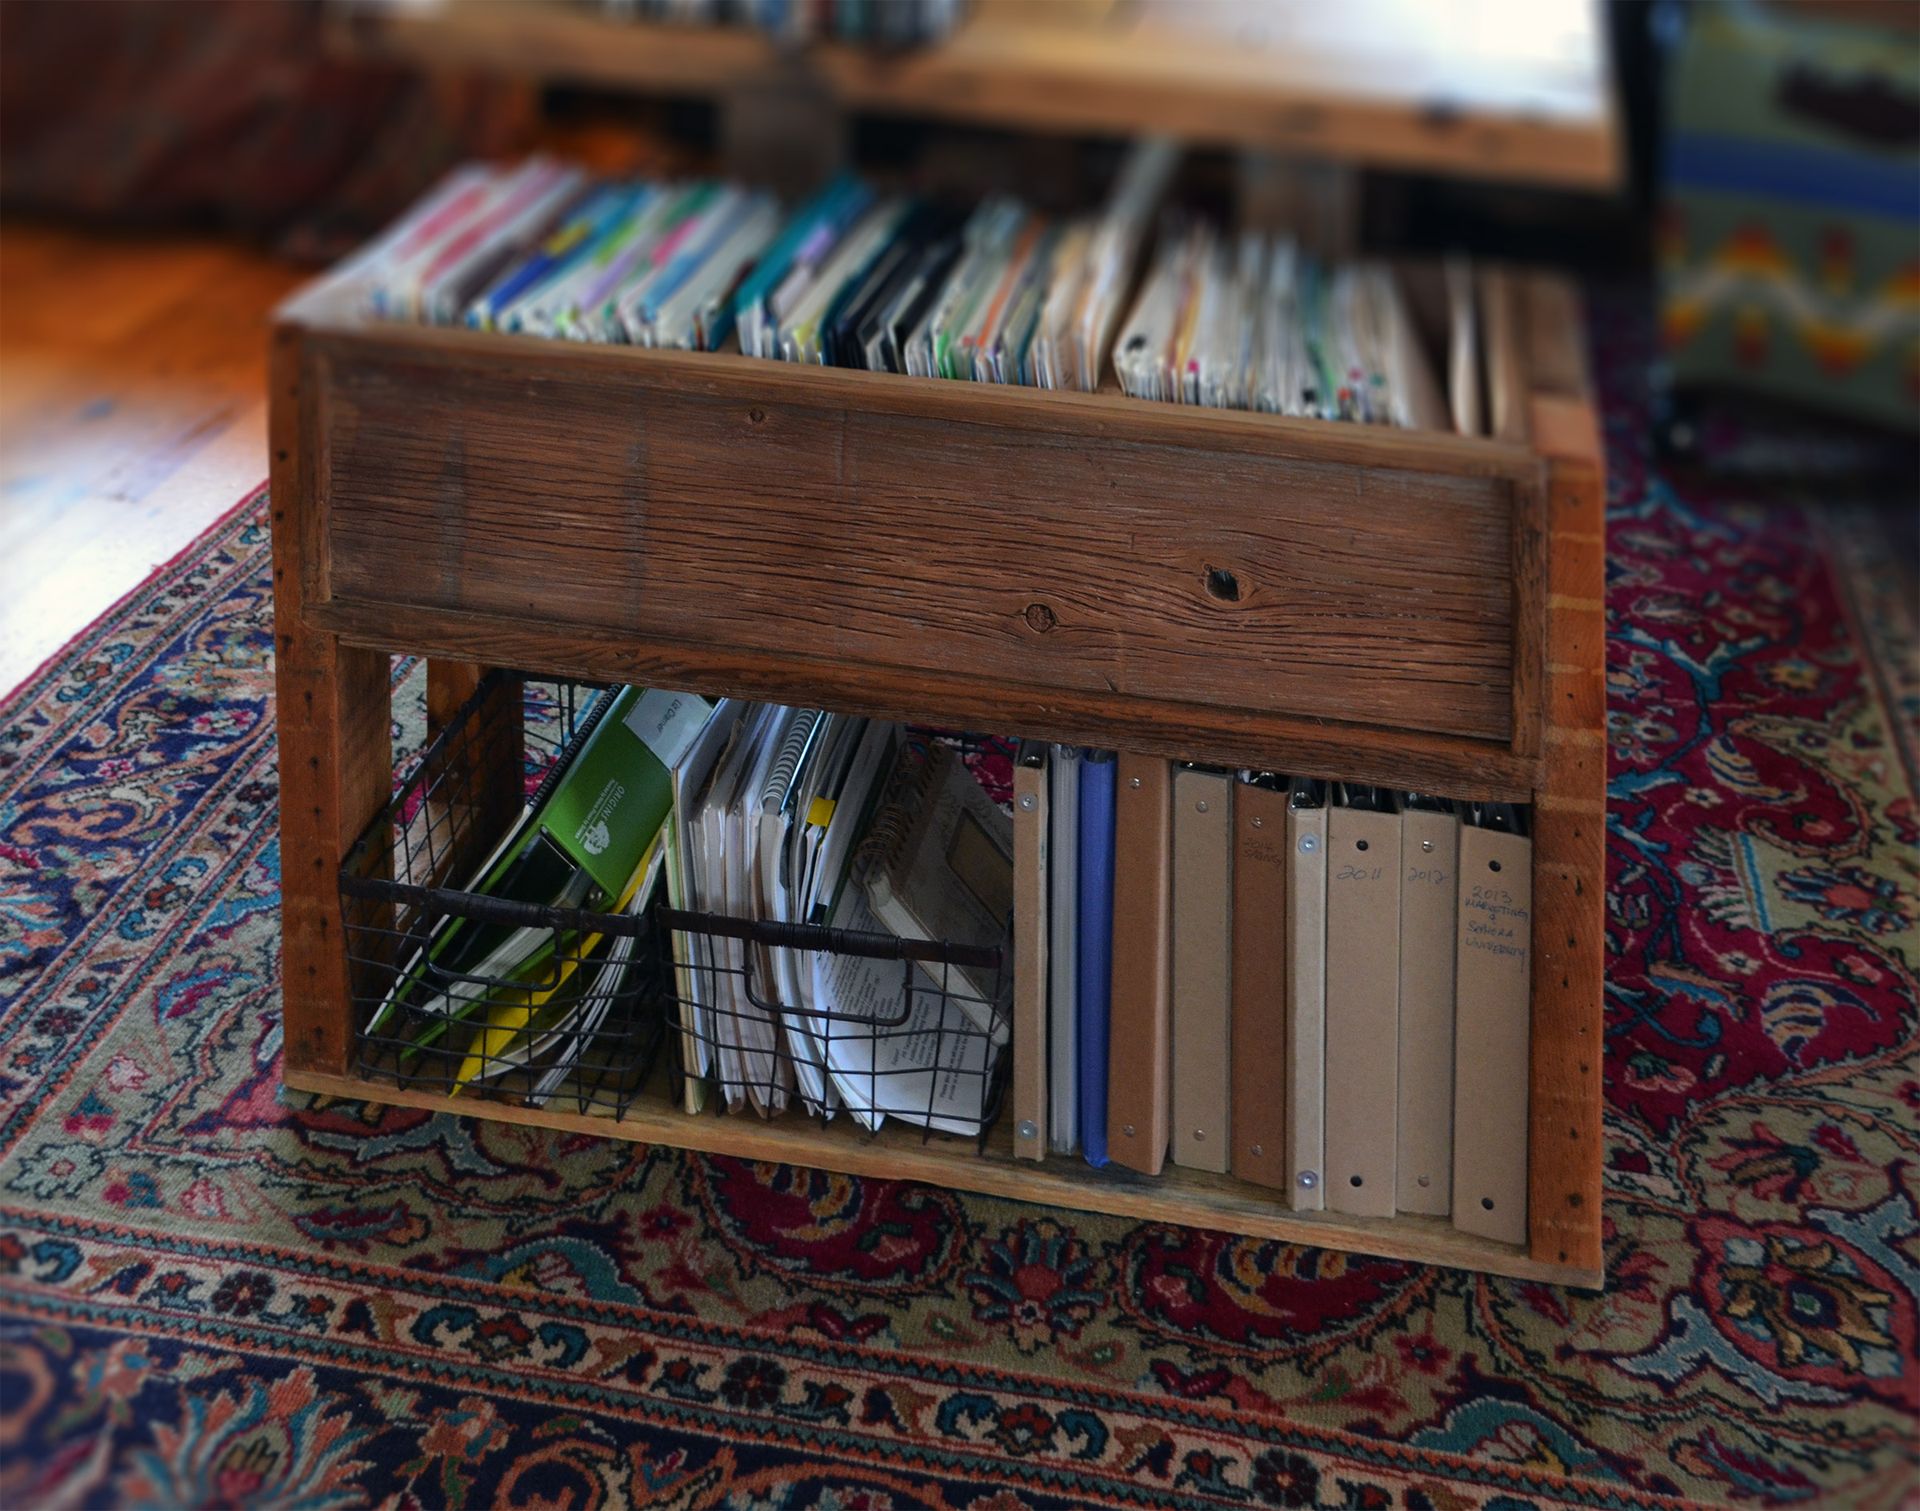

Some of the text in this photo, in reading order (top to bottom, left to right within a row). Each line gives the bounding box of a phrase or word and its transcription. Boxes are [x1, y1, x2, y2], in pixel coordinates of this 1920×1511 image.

[600, 785, 625, 821] ORIGINS
[1336, 865, 1382, 881] 2011
[1407, 867, 1449, 885] 2012
[1472, 885, 1513, 906] 2013
